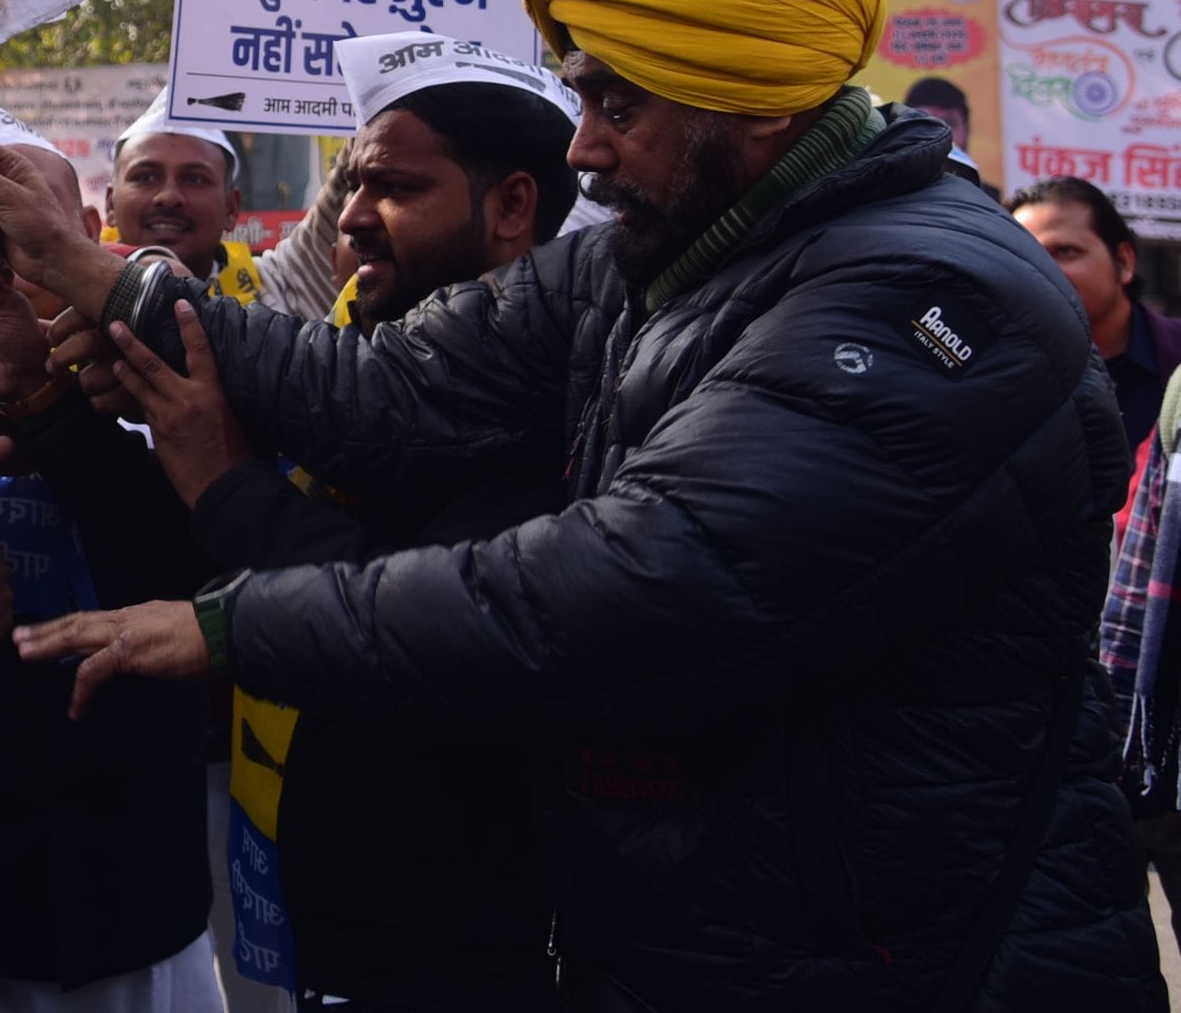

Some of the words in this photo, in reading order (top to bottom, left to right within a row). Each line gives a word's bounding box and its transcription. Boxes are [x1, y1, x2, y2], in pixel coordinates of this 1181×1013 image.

[230, 15, 302, 73] नहीं
[379, 40, 445, 74] आम
[263, 97, 291, 113] आम
[294, 97, 337, 116] आदमी
[914, 330, 934, 350] ITALY
[932, 347, 955, 369] STYLE
[919, 306, 972, 361] ARNOLD
